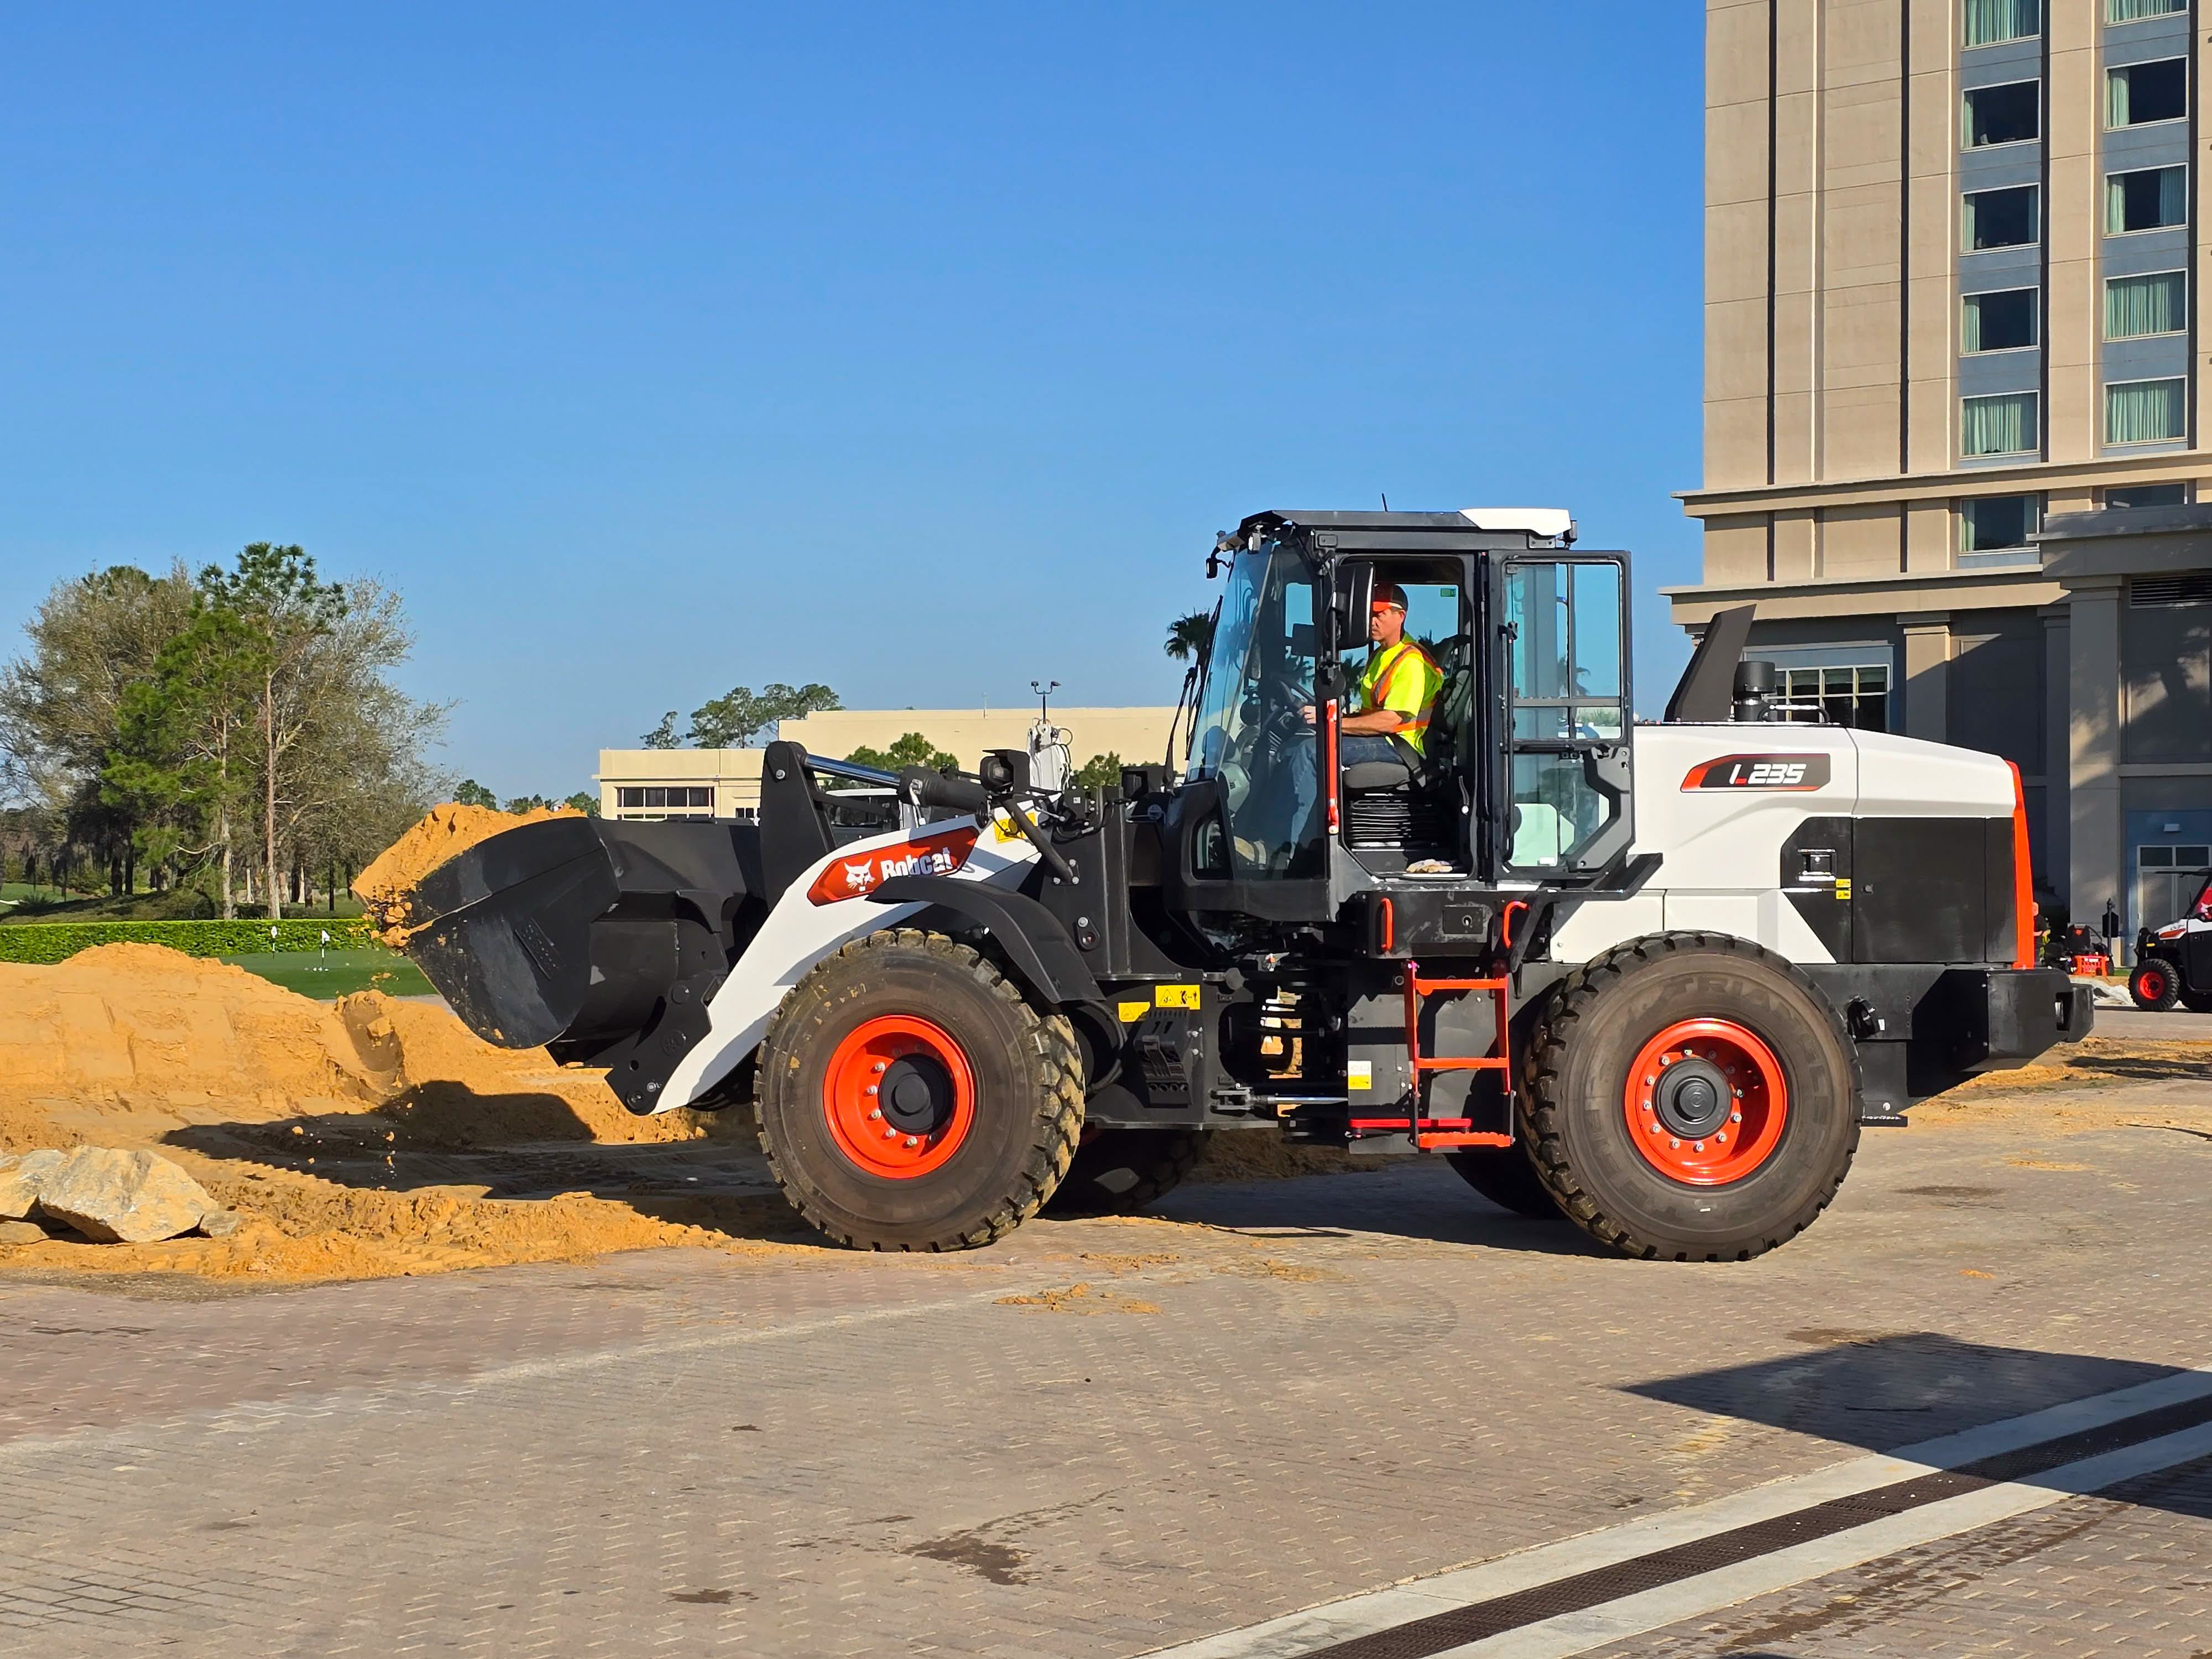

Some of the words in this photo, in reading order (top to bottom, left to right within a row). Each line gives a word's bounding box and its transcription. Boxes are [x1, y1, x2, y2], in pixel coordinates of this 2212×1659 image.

[1729, 763, 1807, 785] L235
[880, 847, 953, 881] Bobcat
[1663, 976, 1829, 1125] TRIANGLE
